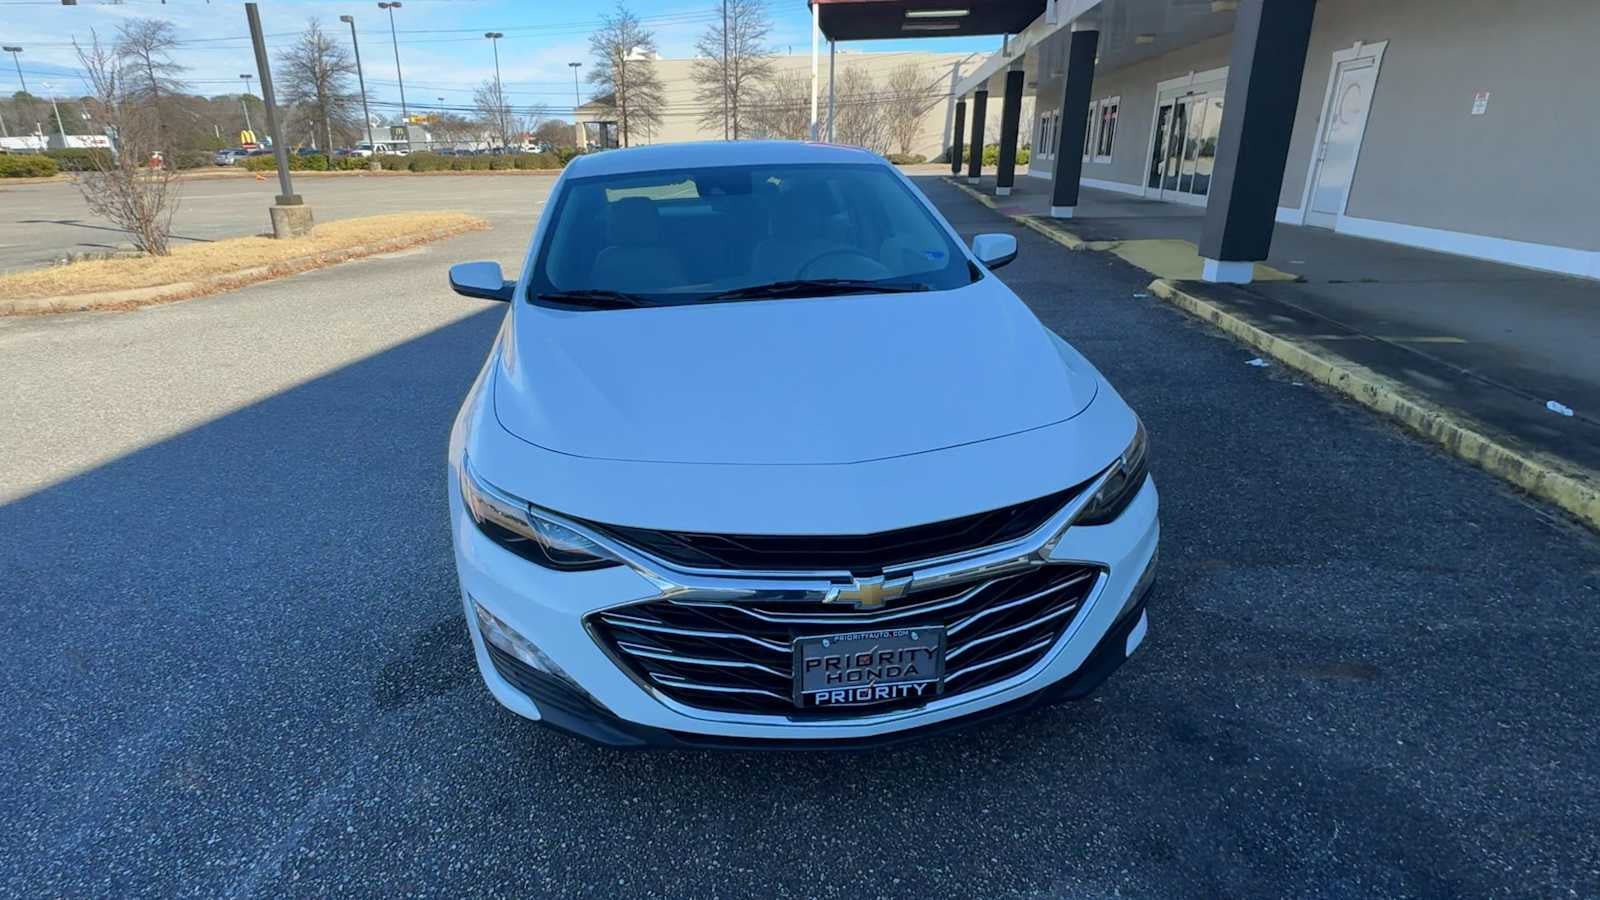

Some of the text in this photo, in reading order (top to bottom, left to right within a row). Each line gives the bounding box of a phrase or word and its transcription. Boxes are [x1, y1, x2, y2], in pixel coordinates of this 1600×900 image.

[805, 645, 938, 672] PRIORITY
[826, 663, 919, 684] HONDA
[815, 683, 928, 705] PRIORITY
